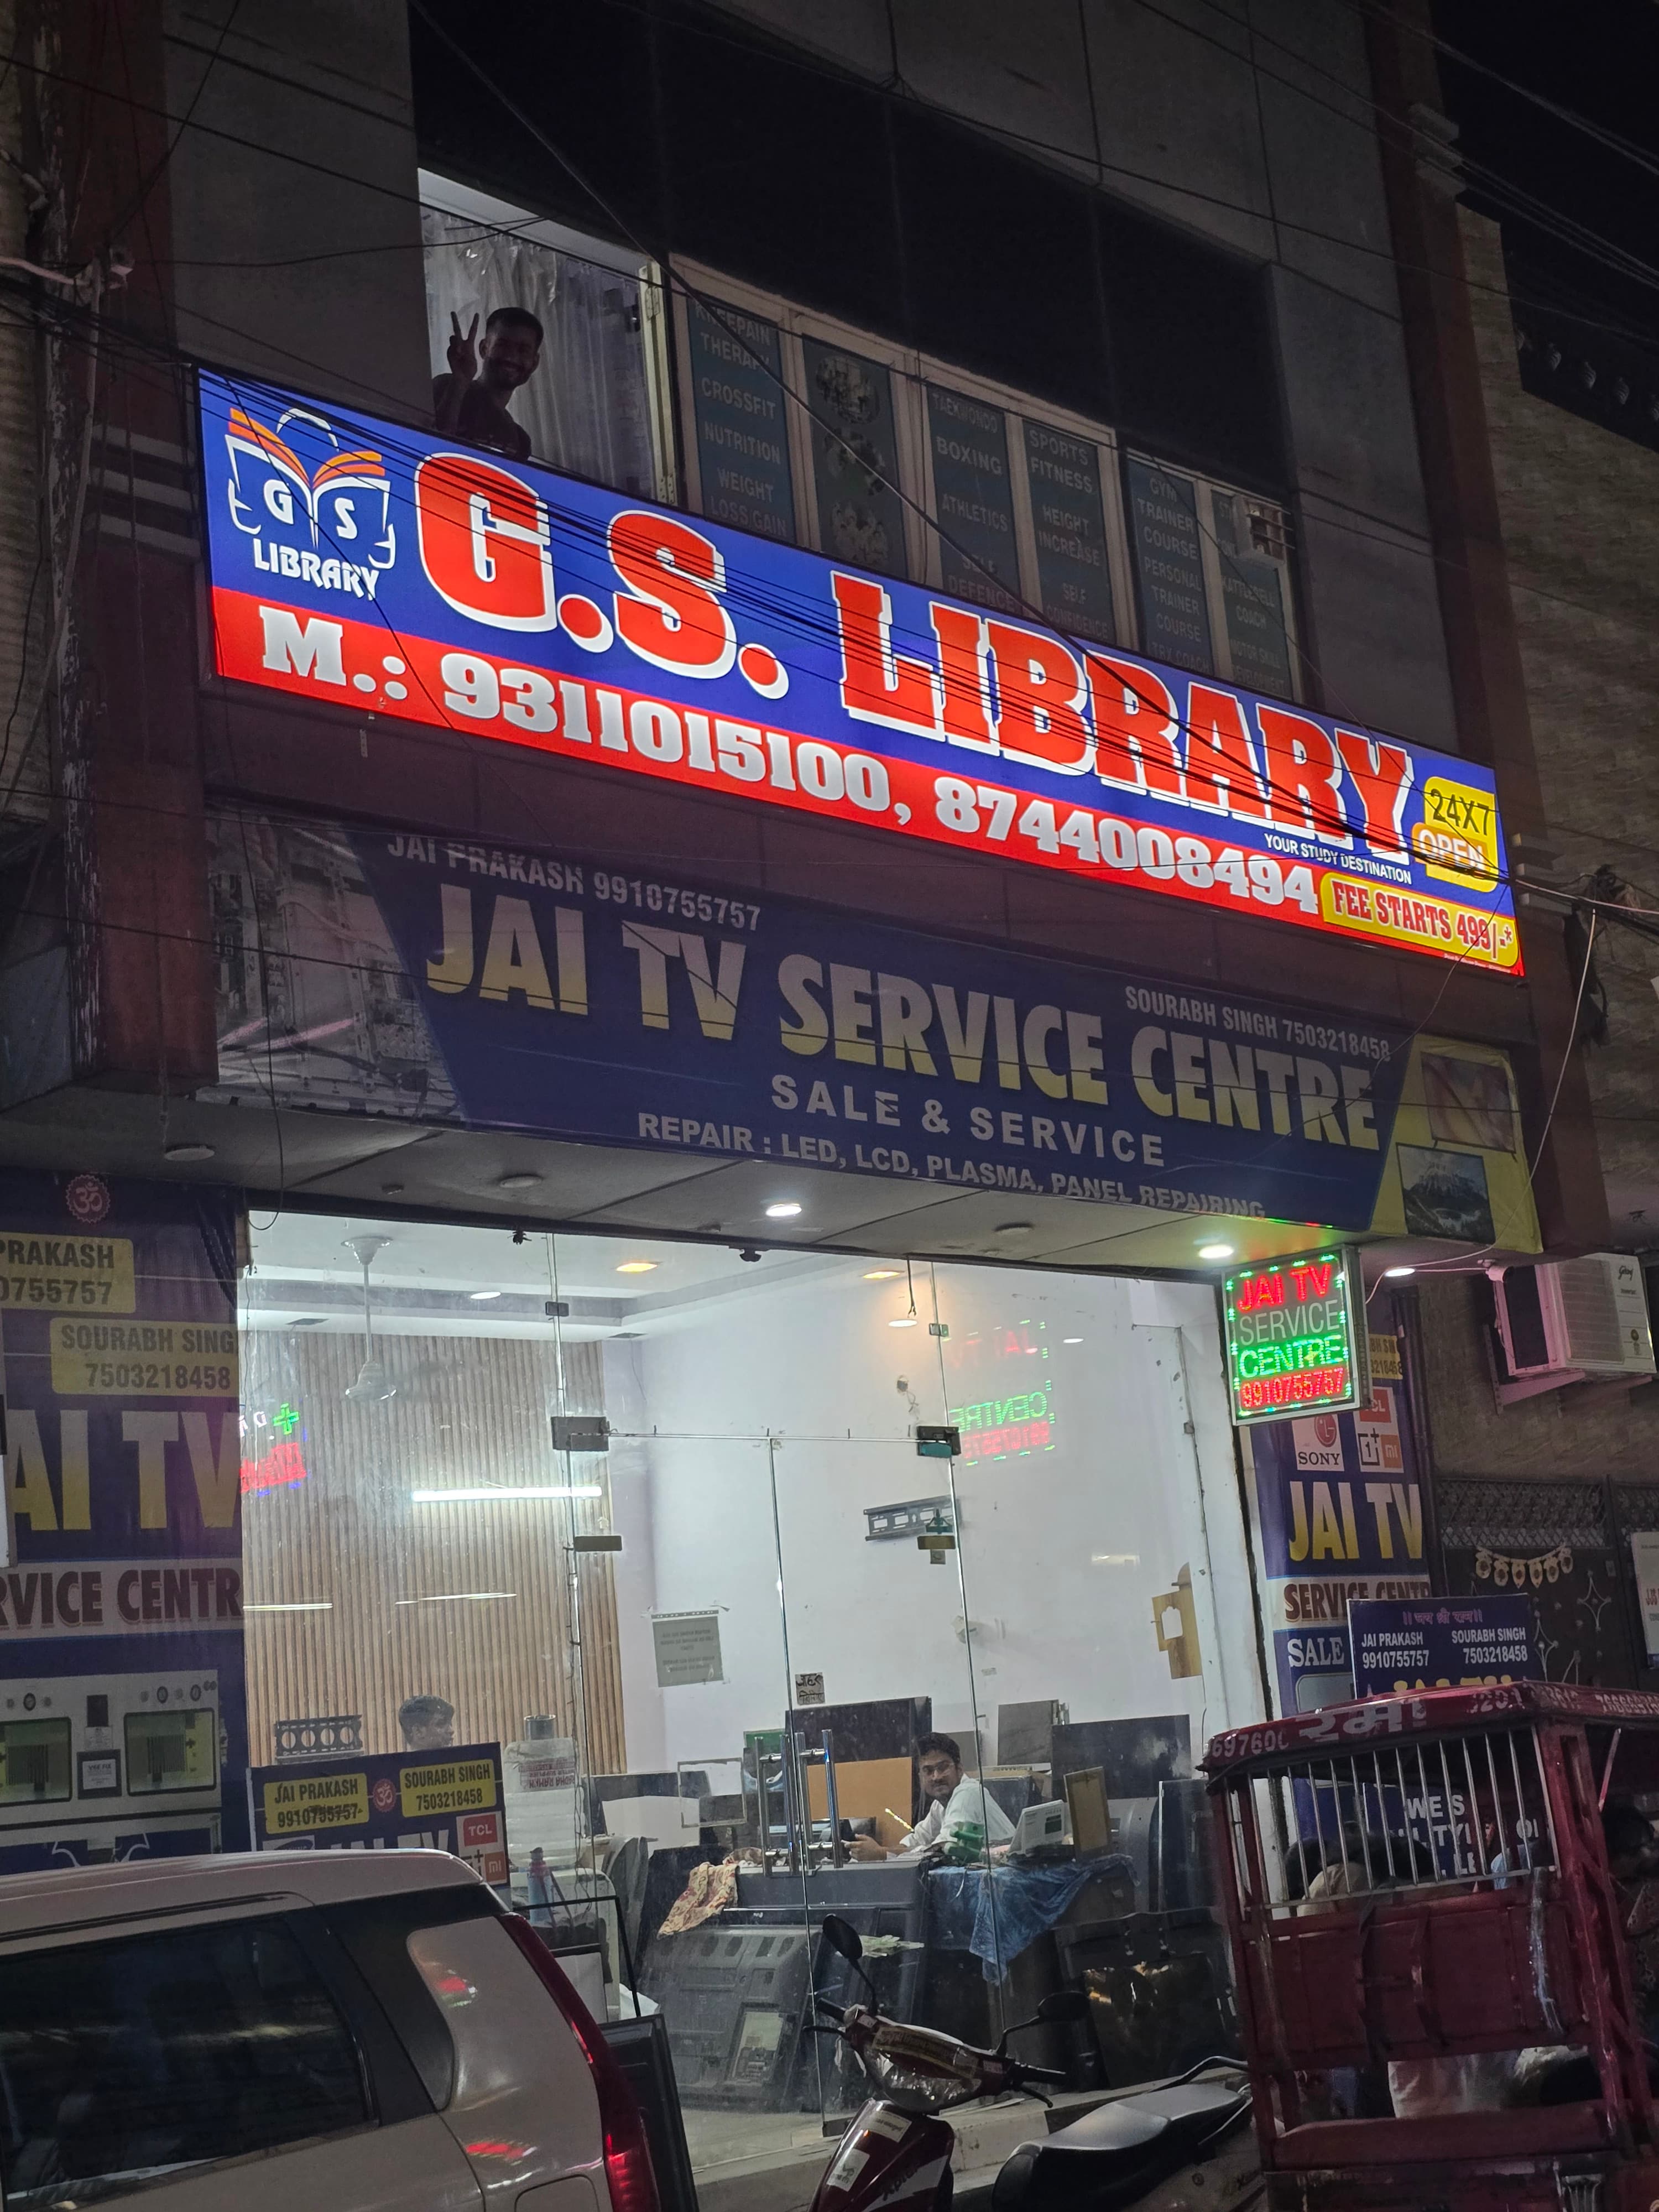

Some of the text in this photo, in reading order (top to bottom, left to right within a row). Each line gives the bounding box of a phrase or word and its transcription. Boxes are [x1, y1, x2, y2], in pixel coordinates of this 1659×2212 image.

[701, 377, 776, 421] CROSSFIT
[704, 421, 781, 465] NUTRITION
[936, 436, 1003, 476] BOXING
[1028, 429, 1089, 466] SPORTS
[717, 467, 774, 504] WEIGHT
[1030, 456, 1093, 494] FITNESS
[1149, 474, 1178, 502] GYM
[263, 479, 358, 540] G S
[942, 493, 1010, 533] ATHLETICS
[1043, 504, 1090, 535] HEIGHT
[1137, 498, 1195, 534] TRAINER
[1038, 531, 1102, 567] INCREASE
[1143, 526, 1198, 561] COURSE
[253, 538, 380, 601] LIBRARY
[1143, 556, 1202, 592] PERSONAL
[1151, 586, 1199, 616] TRAINER
[1155, 613, 1202, 643] COURSE
[415, 452, 1415, 865] G.S. LIBRARY
[440, 653, 912, 826] 9311015100,
[935, 777, 1319, 914] 8744008494
[1431, 787, 1491, 836] 24X7
[1264, 833, 1412, 886] YOUR STUDY DESTINATION
[1418, 828, 1484, 873] OPEN
[388, 835, 761, 931] JAI PRAKASH 9910755757
[1331, 879, 1373, 920] FEE
[1376, 891, 1452, 941] STARTS
[426, 883, 1380, 1151] JAI TV SERVICE CENTRE
[1125, 985, 1392, 1063] SOURABH SINGH 7503218458
[771, 1074, 1166, 1167] SALE & SERVICE
[781, 1133, 848, 1169] LED,
[854, 1144, 920, 1178] LCD,
[926, 1154, 1045, 1193] PLASMA,
[1051, 1172, 1134, 1204] PANEL
[1139, 1182, 1266, 1220] REPAIRING
[1238, 1263, 1332, 1313] JAI TV
[61, 1323, 174, 1353] SOURABH
[1239, 1299, 1340, 1346] SERVICE
[1239, 1334, 1343, 1378] CENTRE
[85, 1363, 231, 1390] 7503218458
[1241, 1366, 1344, 1408] 9910755757
[1367, 1399, 1386, 1412] CL
[122, 1411, 241, 1530] TV
[1298, 1451, 1341, 1466] SONY
[1288, 1480, 1423, 1562] JAI TV
[1287, 1637, 1345, 1668] SALE
[1361, 1631, 1423, 1647] JAI PRAKASH
[1451, 1627, 1526, 1644] SOURABH SINGH
[1362, 1650, 1430, 1669] 9910755757
[1463, 1645, 1528, 1665] 7503218458
[274, 1778, 359, 1804] JAI PRAKASH
[404, 1763, 491, 1789] SOURABH SINGH
[416, 1788, 483, 1812] 7503218458
[468, 1825, 493, 1838] TCL
